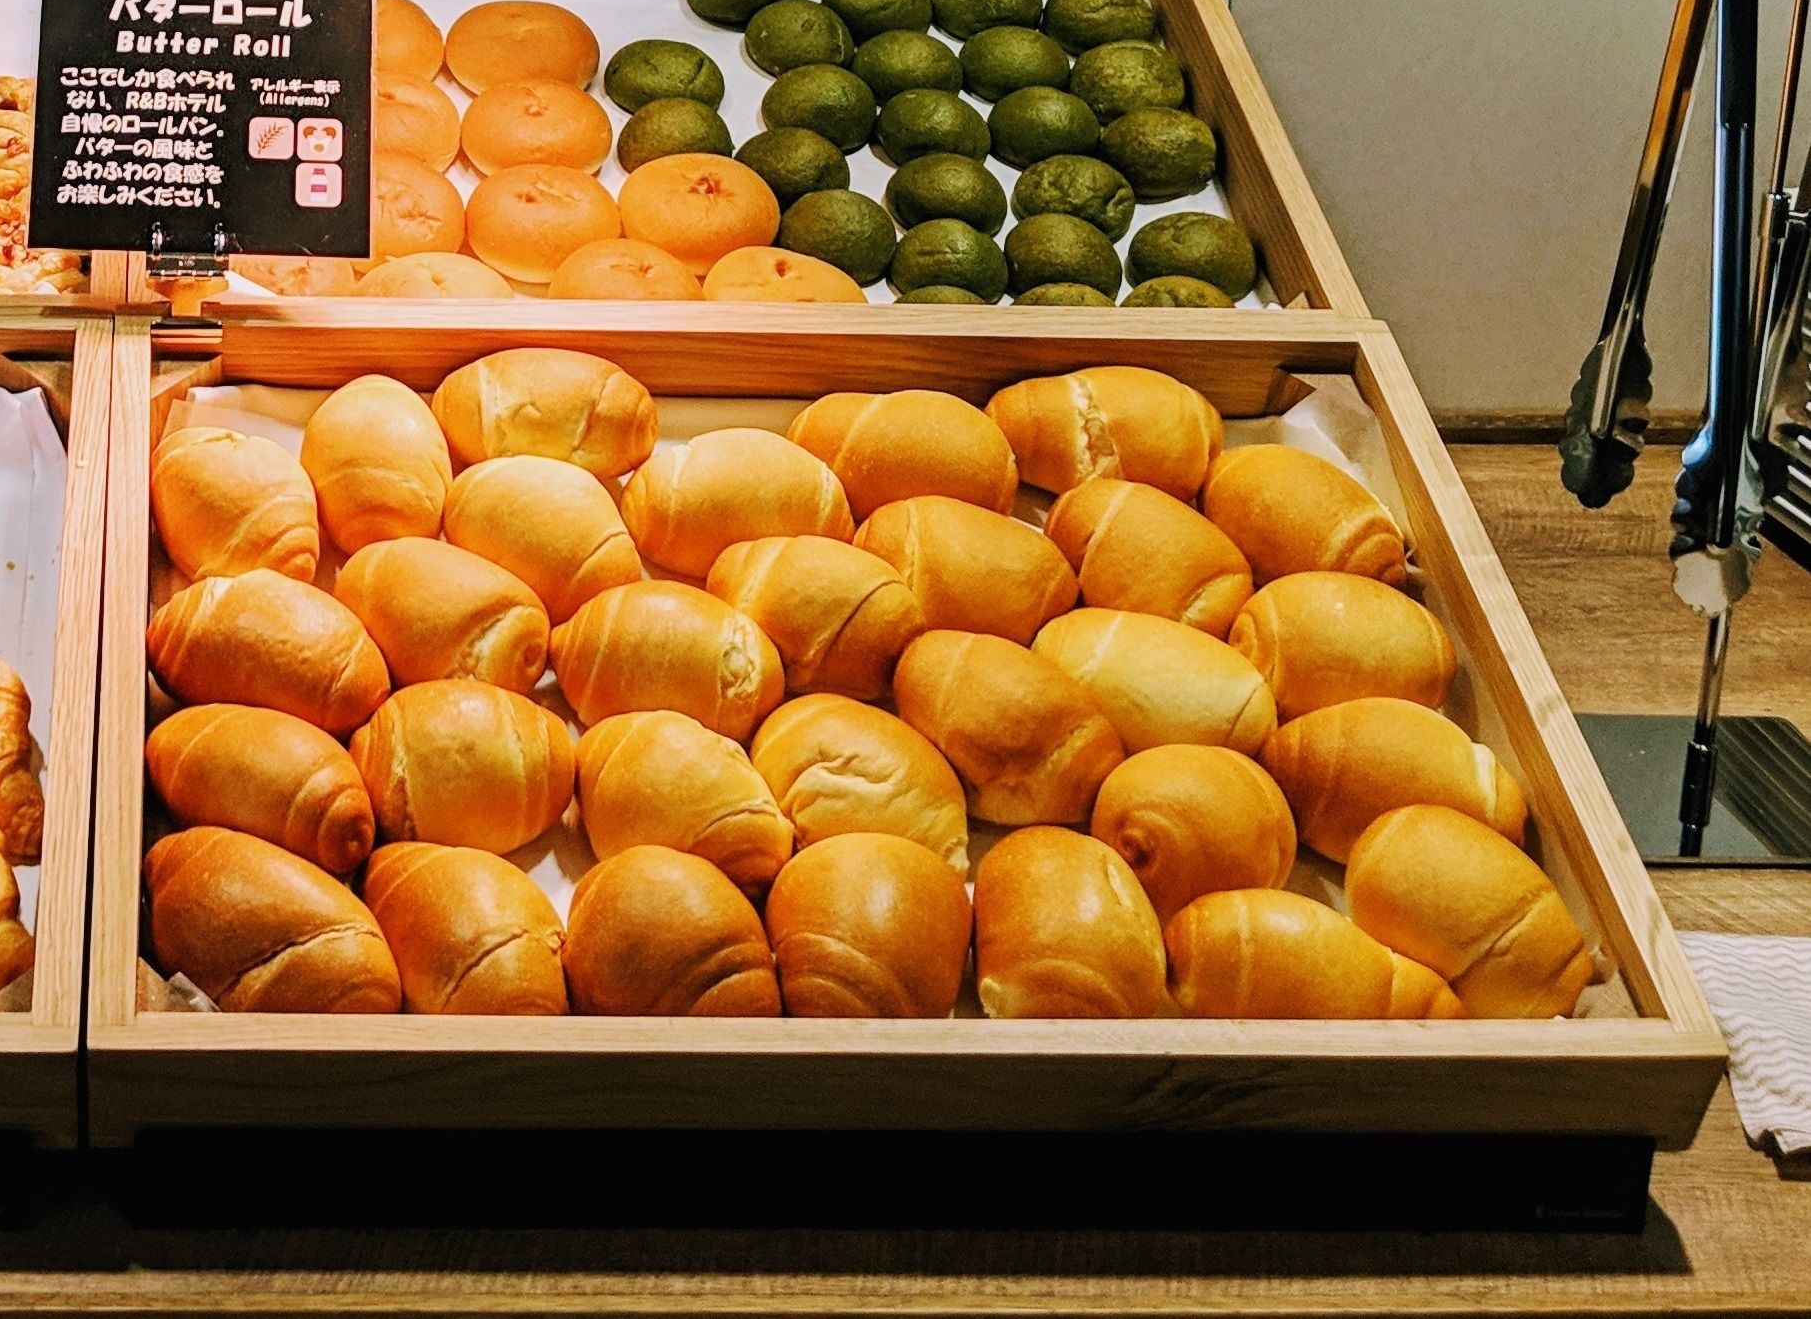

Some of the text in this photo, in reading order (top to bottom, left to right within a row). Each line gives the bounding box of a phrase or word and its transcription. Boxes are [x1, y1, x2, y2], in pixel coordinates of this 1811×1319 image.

[116, 31, 290, 57] Butter Roll
[60, 67, 235, 90] ここでしか食べられ
[75, 137, 213, 160] バターの風味と
[62, 160, 224, 184] ふわふわの食感を
[57, 183, 220, 209] お楽しみください。
